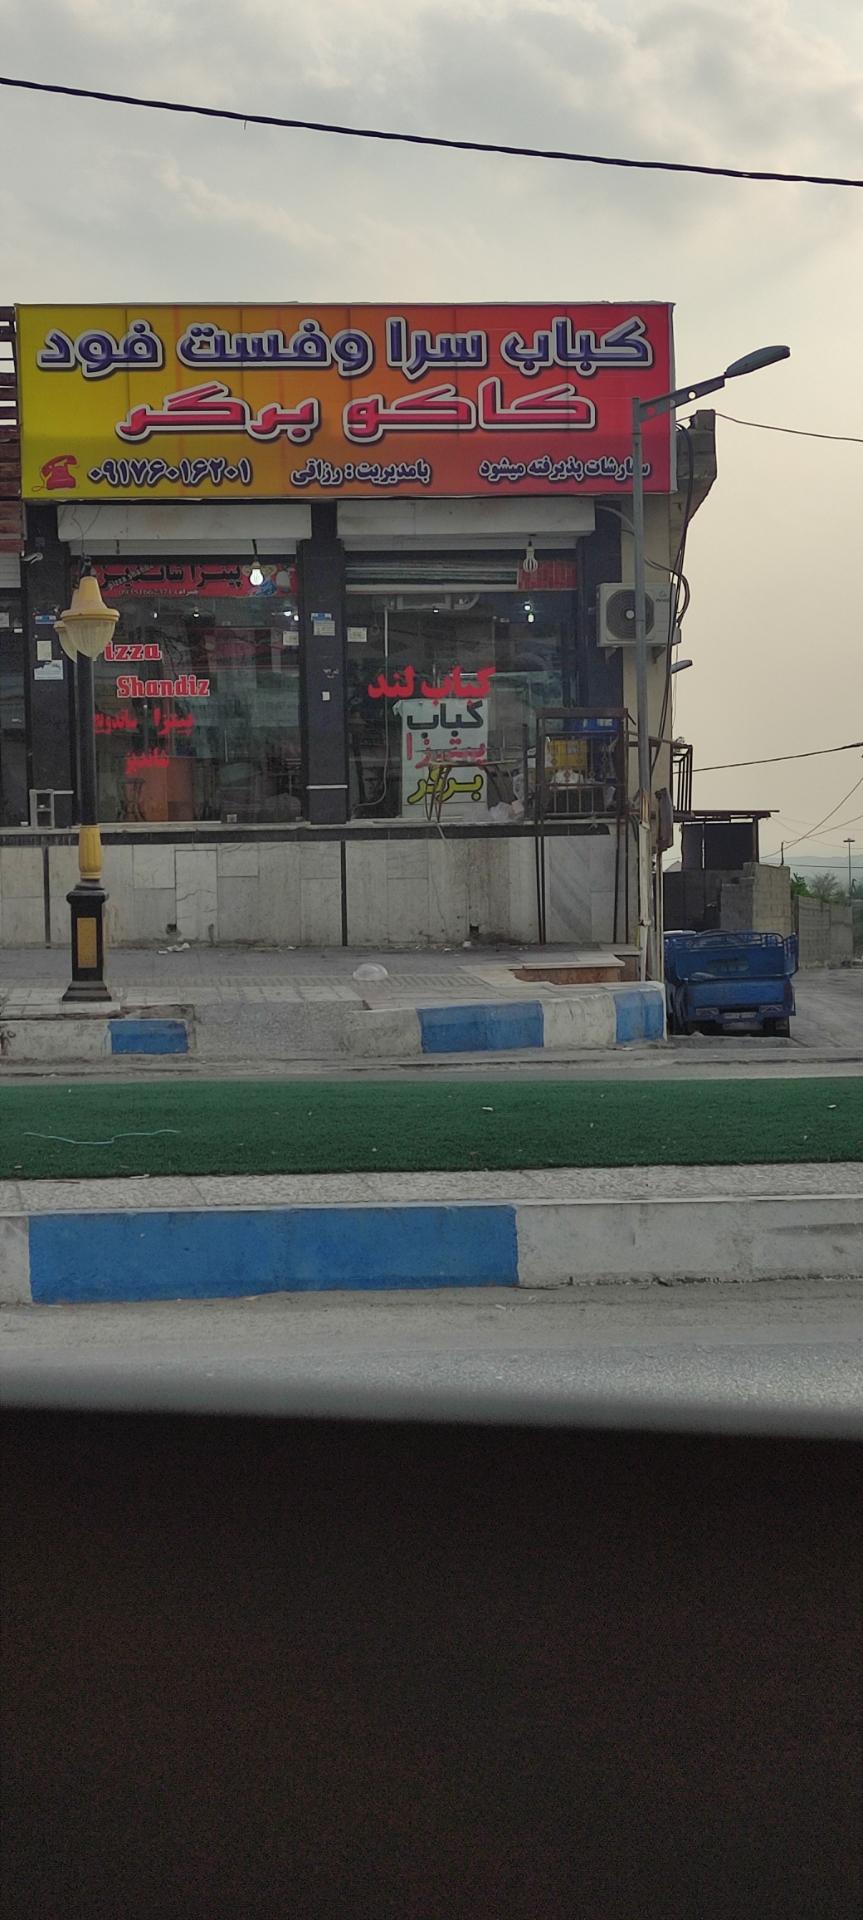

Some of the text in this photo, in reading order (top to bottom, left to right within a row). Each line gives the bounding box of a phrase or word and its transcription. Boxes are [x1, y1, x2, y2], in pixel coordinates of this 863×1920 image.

[38, 319, 163, 378] فود
[387, 317, 487, 380] سرا
[501, 316, 652, 376] کباب
[115, 377, 595, 443] کاکو برگر
[291, 458, 342, 484] رزاقی
[479, 457, 525, 480] میشود
[528, 456, 584, 481] پذیرفته
[104, 640, 162, 661] izza
[116, 674, 210, 698] Shandiz
[367, 664, 496, 708] کباب لند
[406, 700, 484, 739] کباب
